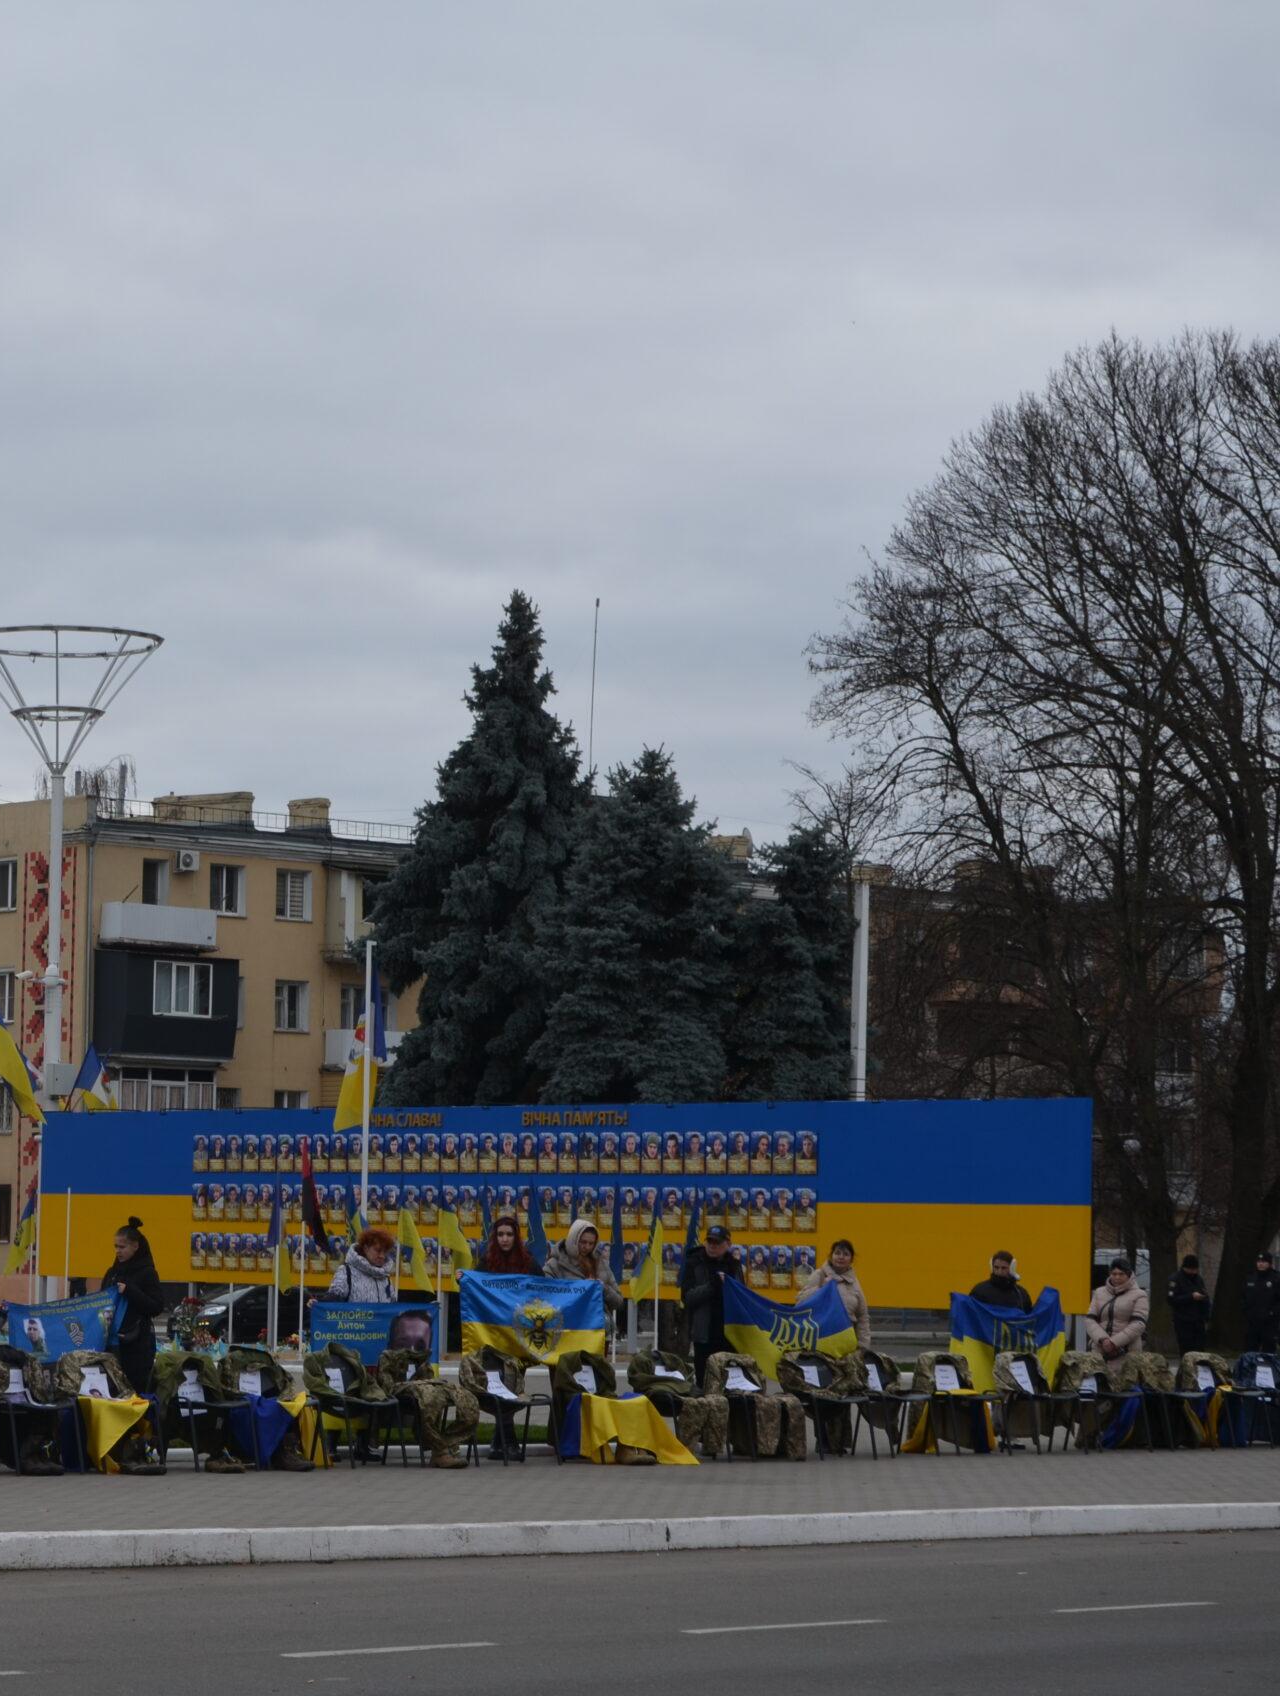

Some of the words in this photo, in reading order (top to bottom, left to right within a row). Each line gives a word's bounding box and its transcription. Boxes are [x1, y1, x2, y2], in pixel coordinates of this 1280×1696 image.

[369, 1112, 394, 1127] ЧНА
[397, 1112, 442, 1127] СЛАВА!
[522, 1111, 560, 1126] ВІЧНА
[337, 1321, 366, 1330] Антон
[313, 1330, 388, 1342] Олександрович
